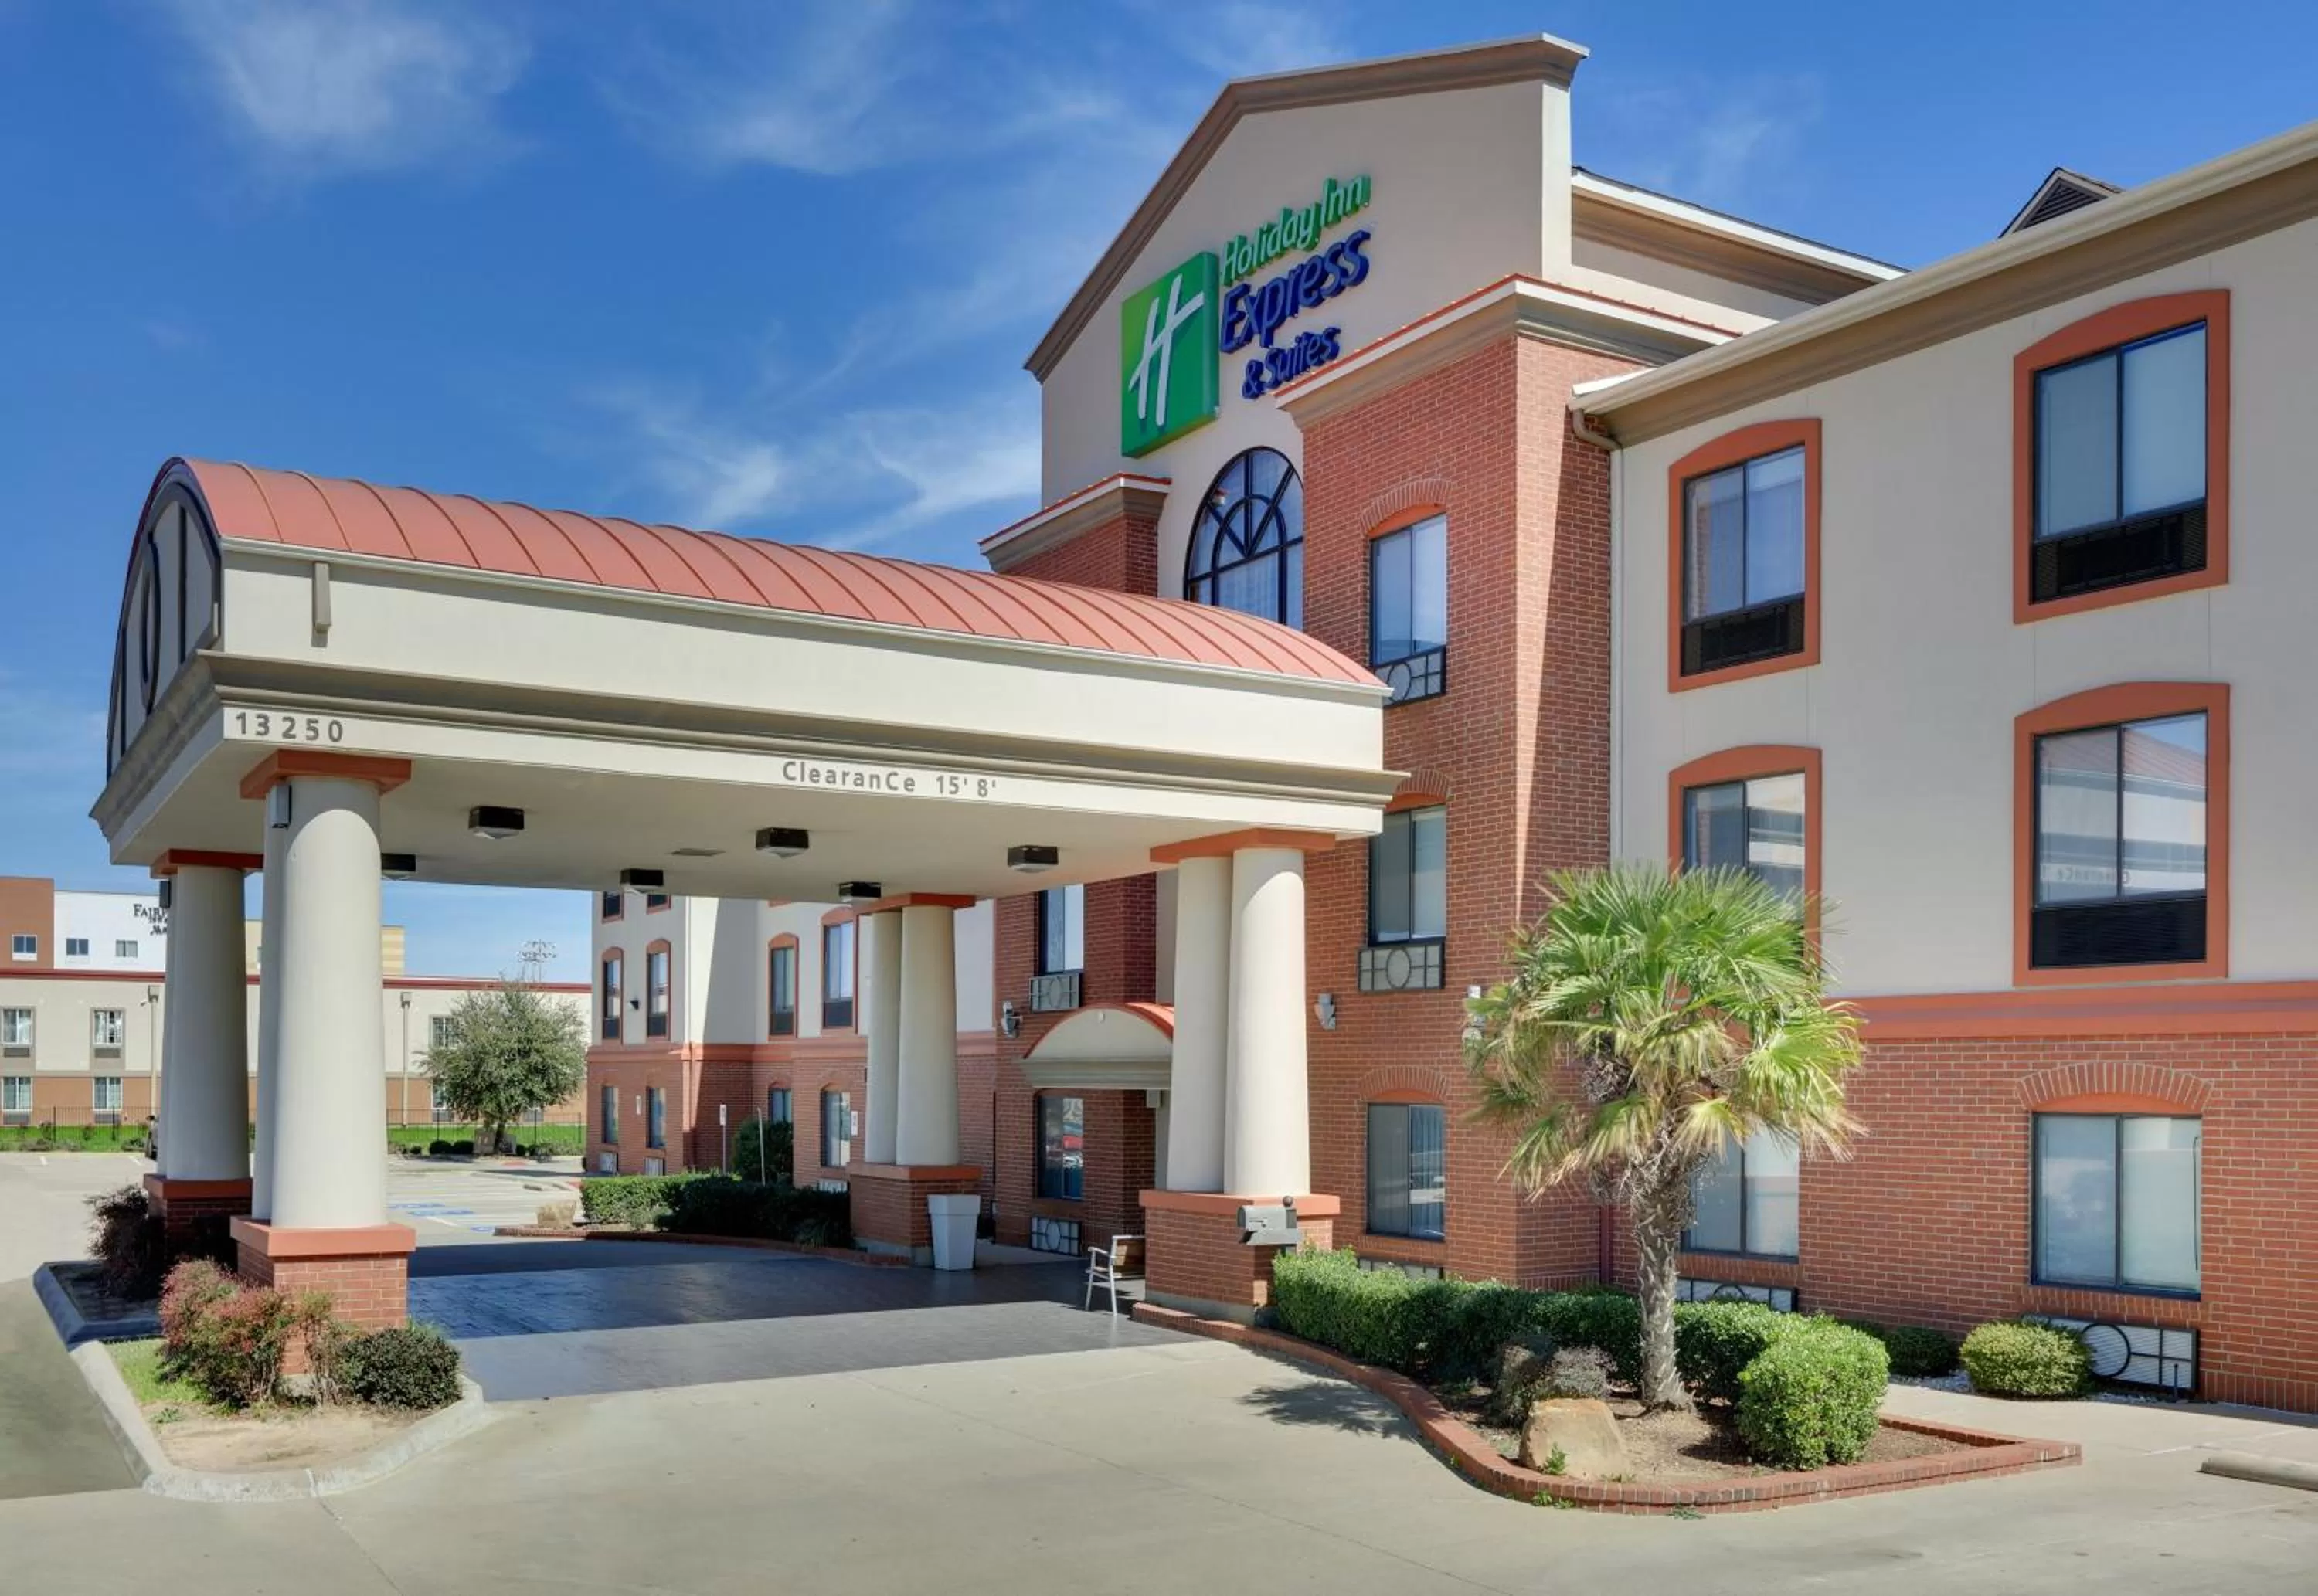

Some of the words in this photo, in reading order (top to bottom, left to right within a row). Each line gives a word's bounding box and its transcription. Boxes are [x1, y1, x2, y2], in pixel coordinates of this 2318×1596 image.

[1222, 202, 1320, 287] Holiday
[1318, 175, 1371, 228] Inn
[1220, 229, 1371, 354] Express
[1241, 358, 1266, 399] &
[1263, 327, 1341, 389] Suites
[235, 711, 343, 742] 13250
